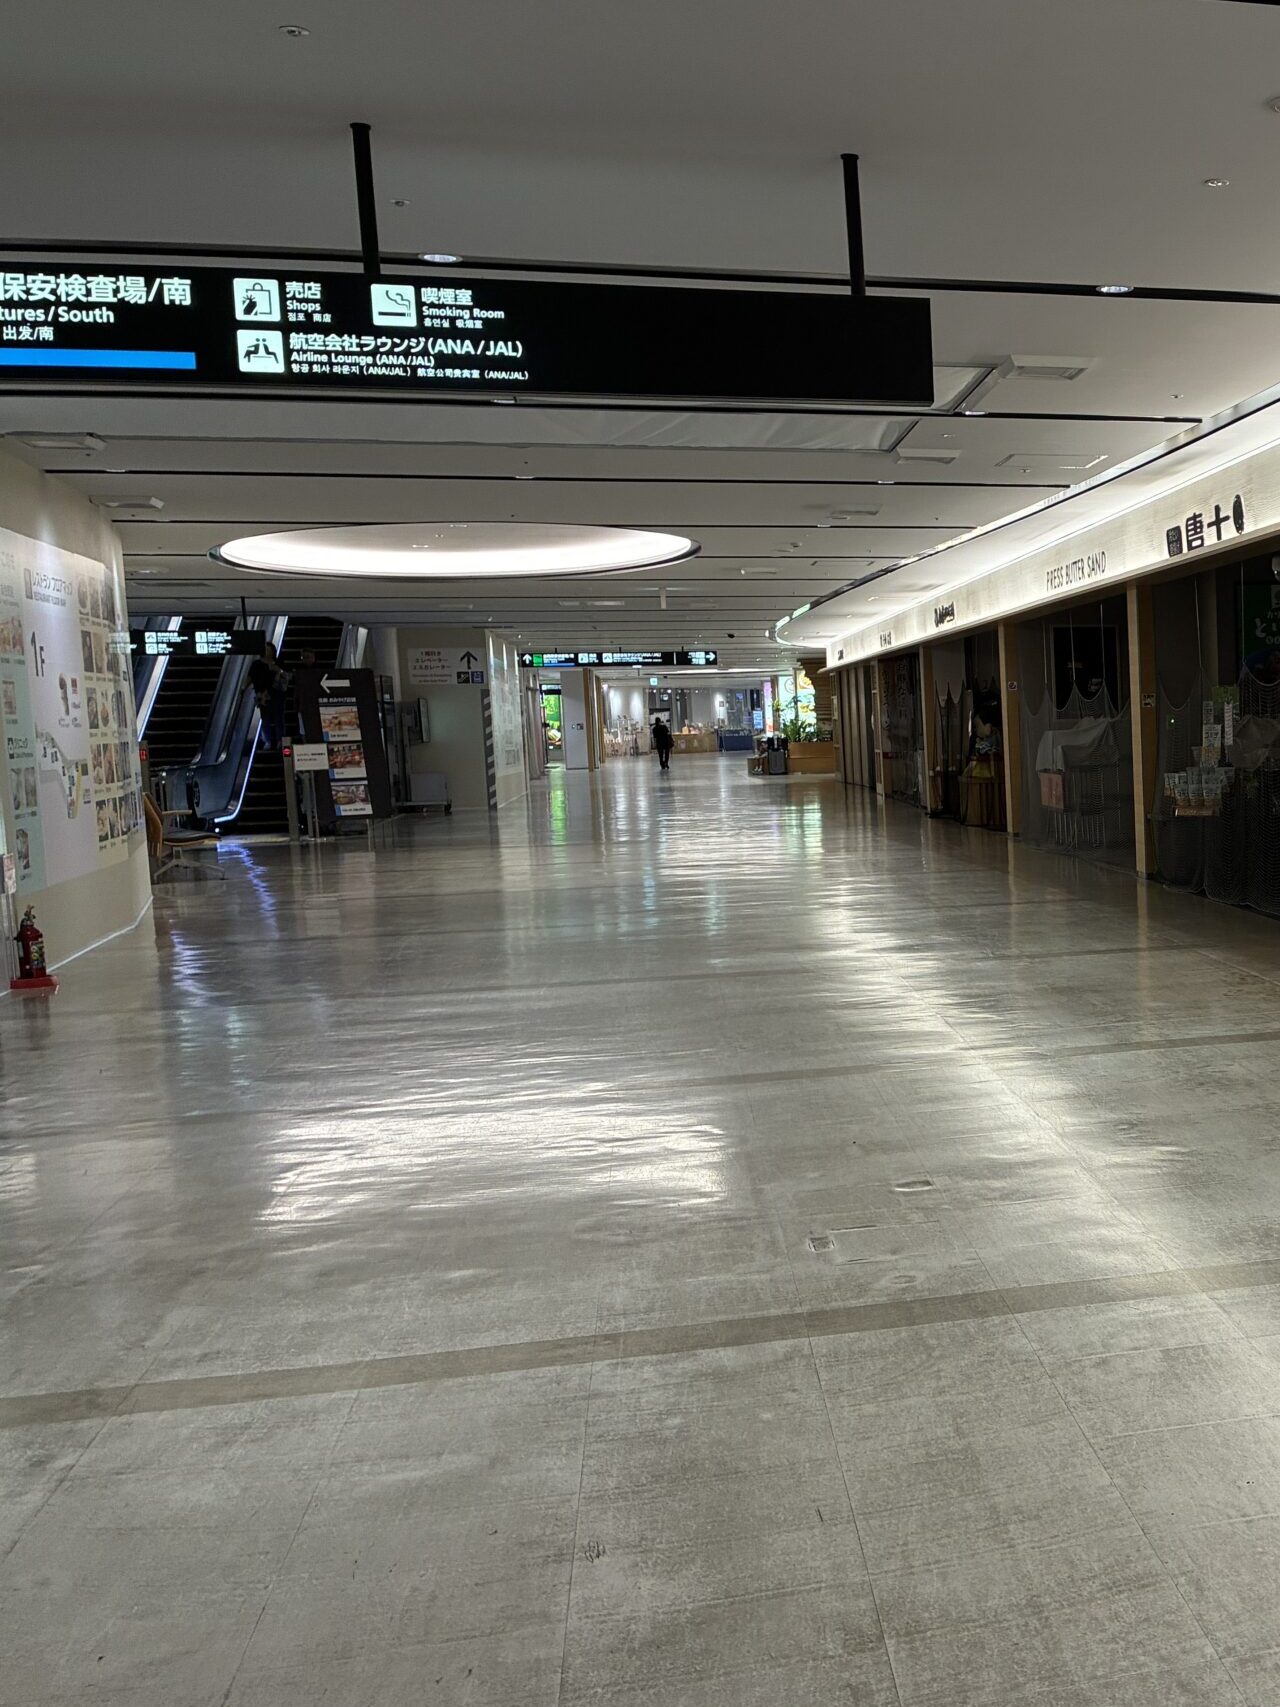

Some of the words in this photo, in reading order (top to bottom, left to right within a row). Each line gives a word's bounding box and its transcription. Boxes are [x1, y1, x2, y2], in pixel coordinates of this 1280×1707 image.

[285, 281, 322, 299] 売店
[421, 287, 473, 305] 喫煙室
[58, 306, 115, 323] South
[286, 300, 321, 312] Shops
[422, 306, 470, 319] Smoking
[473, 308, 505, 319] Room
[290, 351, 328, 362] Airline
[331, 353, 373, 366] Lounge
[1046, 565, 1064, 592] PRESS
[1065, 557, 1085, 586] BUTTER
[1087, 550, 1107, 578] SAND
